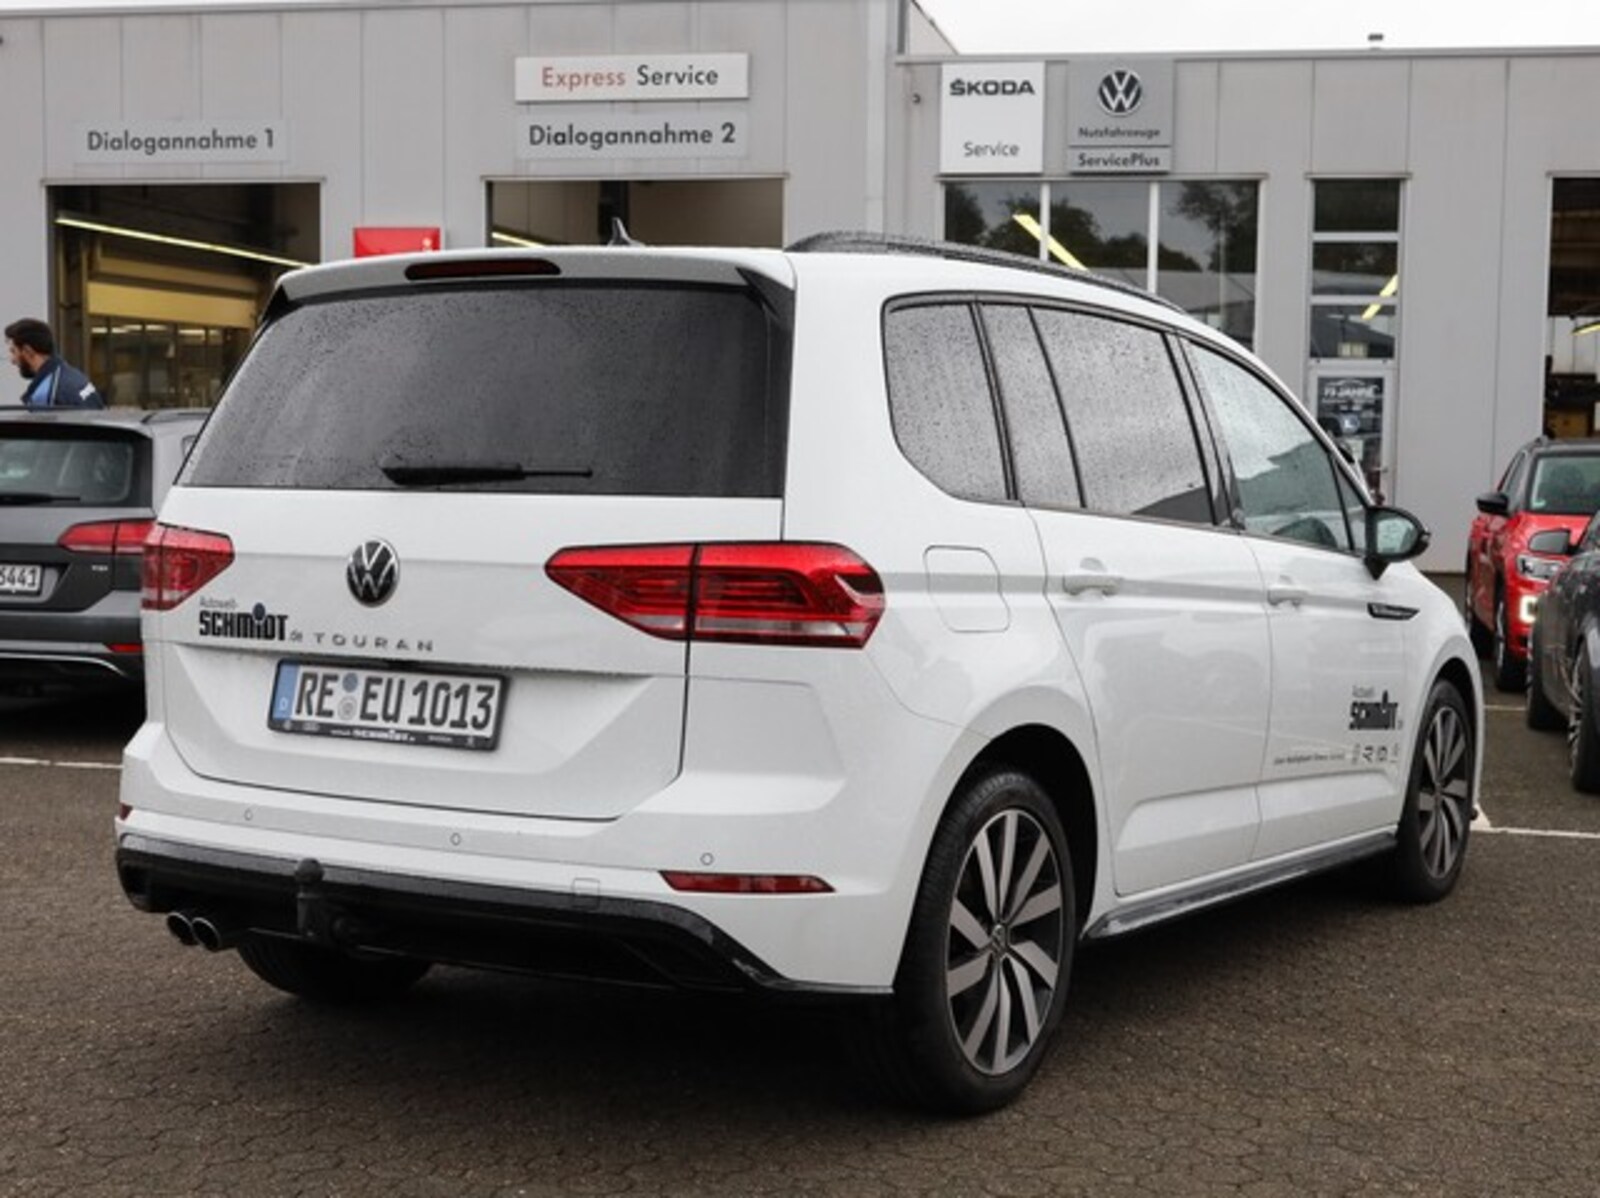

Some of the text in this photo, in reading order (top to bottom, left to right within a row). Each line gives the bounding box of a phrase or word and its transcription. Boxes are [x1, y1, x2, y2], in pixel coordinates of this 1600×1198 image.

[541, 64, 719, 92] Express Service
[87, 127, 275, 156] Dialogannahme 1
[528, 122, 736, 151] Dialogannahme 2
[1078, 128, 1161, 140] Nutzfahrzeuge
[964, 141, 1020, 157] Service
[1078, 152, 1160, 168] ServicePlus
[199, 603, 288, 640] SCHMIDT
[314, 632, 434, 652] TOURAN
[296, 672, 339, 717] RE
[360, 676, 407, 724] EU
[408, 680, 495, 729] 1013
